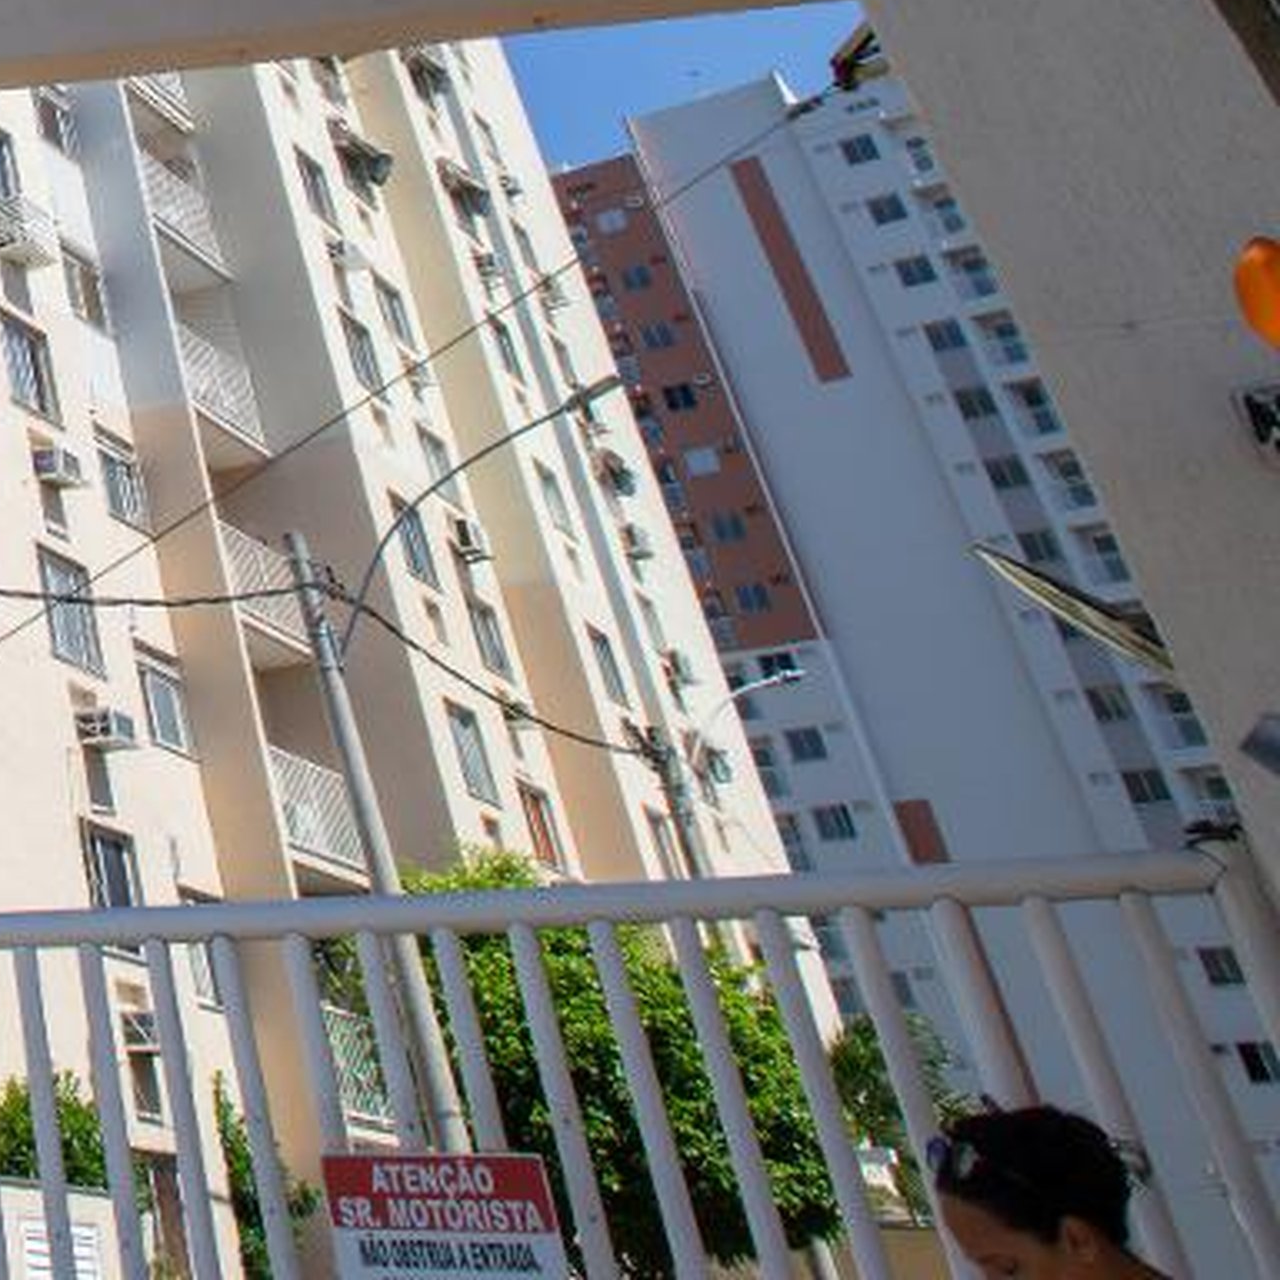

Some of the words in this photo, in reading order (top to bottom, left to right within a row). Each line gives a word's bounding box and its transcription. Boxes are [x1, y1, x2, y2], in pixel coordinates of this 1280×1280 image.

[371, 1159, 495, 1198] ATENÇÃO
[339, 1195, 383, 1228] SR.
[390, 1198, 545, 1232] MOTORISTA
